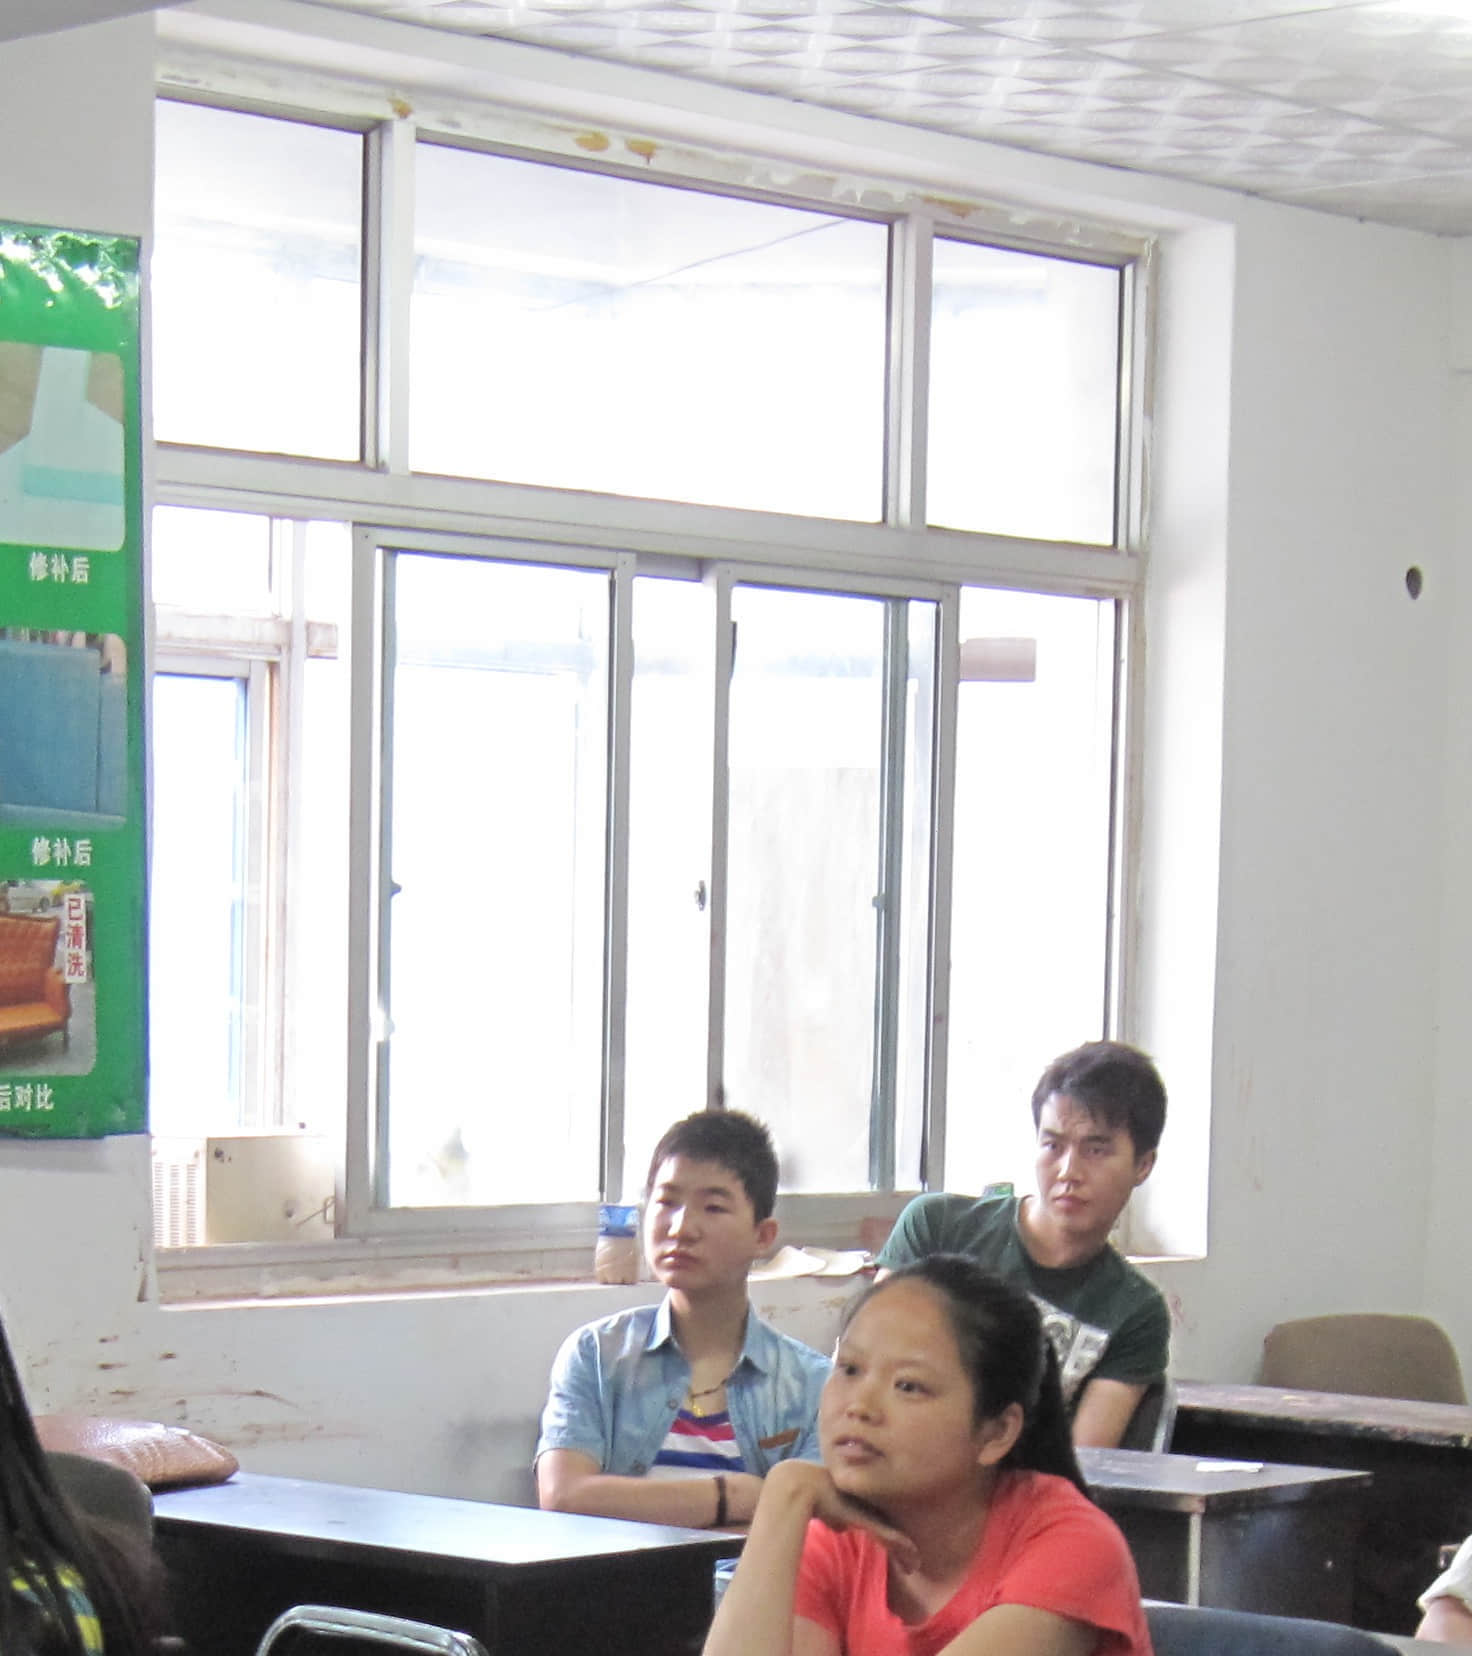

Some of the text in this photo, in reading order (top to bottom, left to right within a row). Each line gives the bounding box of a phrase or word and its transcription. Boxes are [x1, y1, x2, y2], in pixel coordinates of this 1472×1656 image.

[29, 551, 90, 584] 修补后
[31, 836, 92, 866] 修补后
[65, 897, 86, 977] 已清洗
